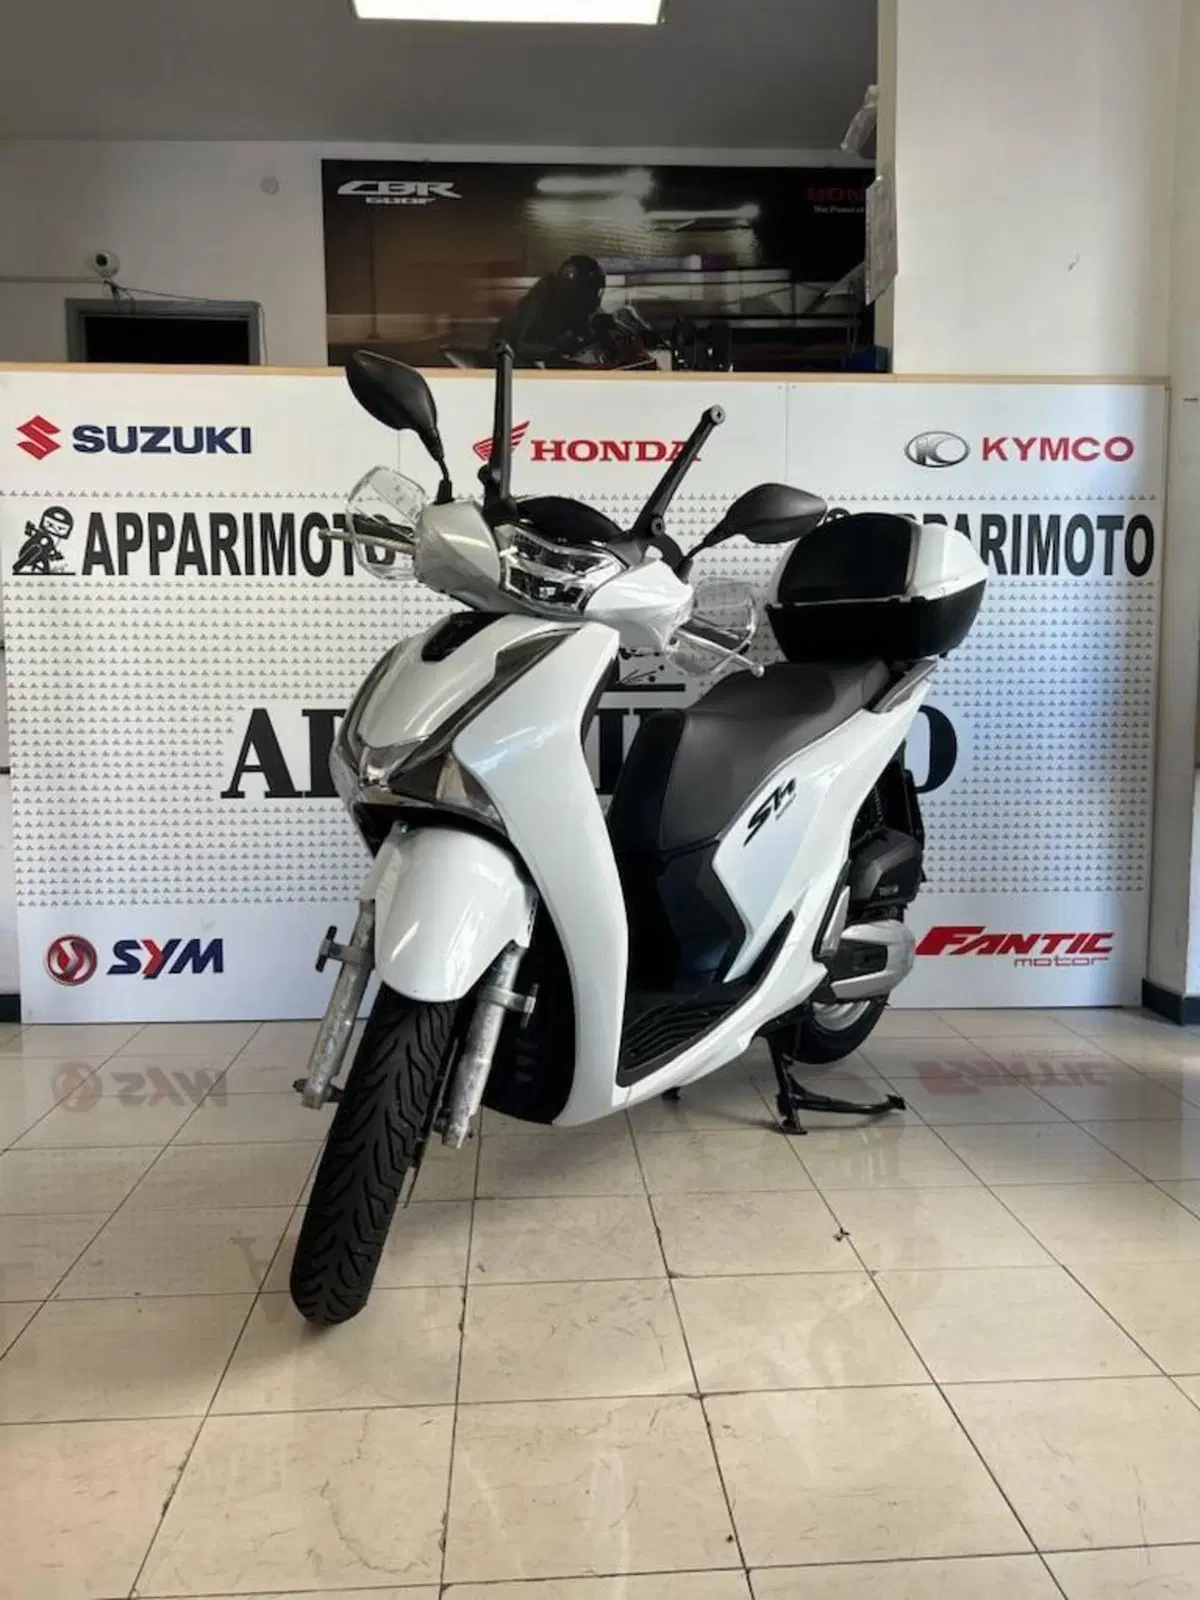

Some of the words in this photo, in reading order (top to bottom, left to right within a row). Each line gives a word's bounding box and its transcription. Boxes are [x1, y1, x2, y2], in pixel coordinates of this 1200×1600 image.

[337, 180, 463, 199] CBR
[807, 187, 866, 201] HON
[72, 424, 252, 454] SUZUKI
[981, 436, 1134, 462] KYMCO
[922, 513, 1155, 577] RIMOTO
[107, 938, 224, 979] SYM
[1013, 957, 1110, 967] motor
